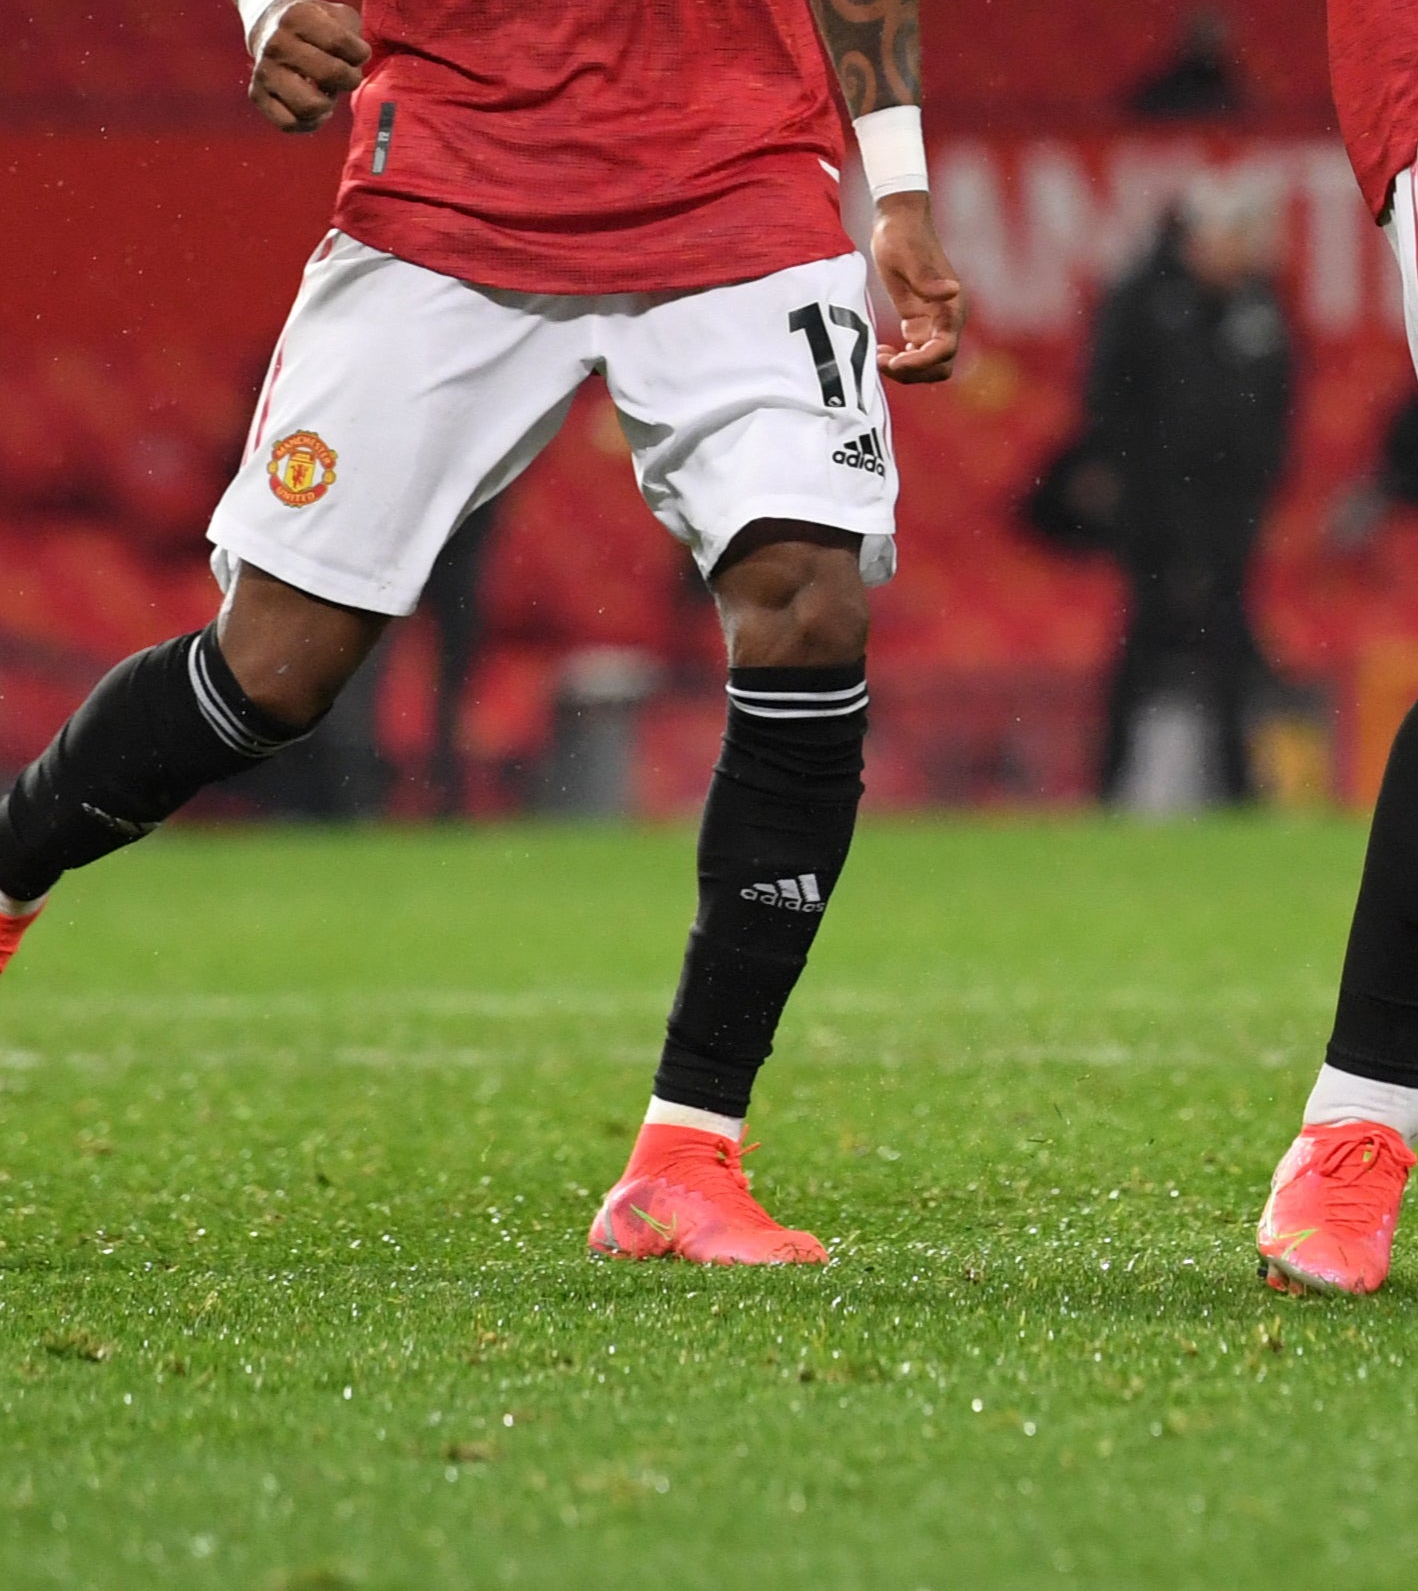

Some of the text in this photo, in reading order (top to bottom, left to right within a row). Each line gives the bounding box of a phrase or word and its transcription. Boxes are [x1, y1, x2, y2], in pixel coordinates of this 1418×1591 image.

[788, 301, 869, 417] 17
[832, 449, 886, 479] adida
[740, 888, 825, 913] adidas
